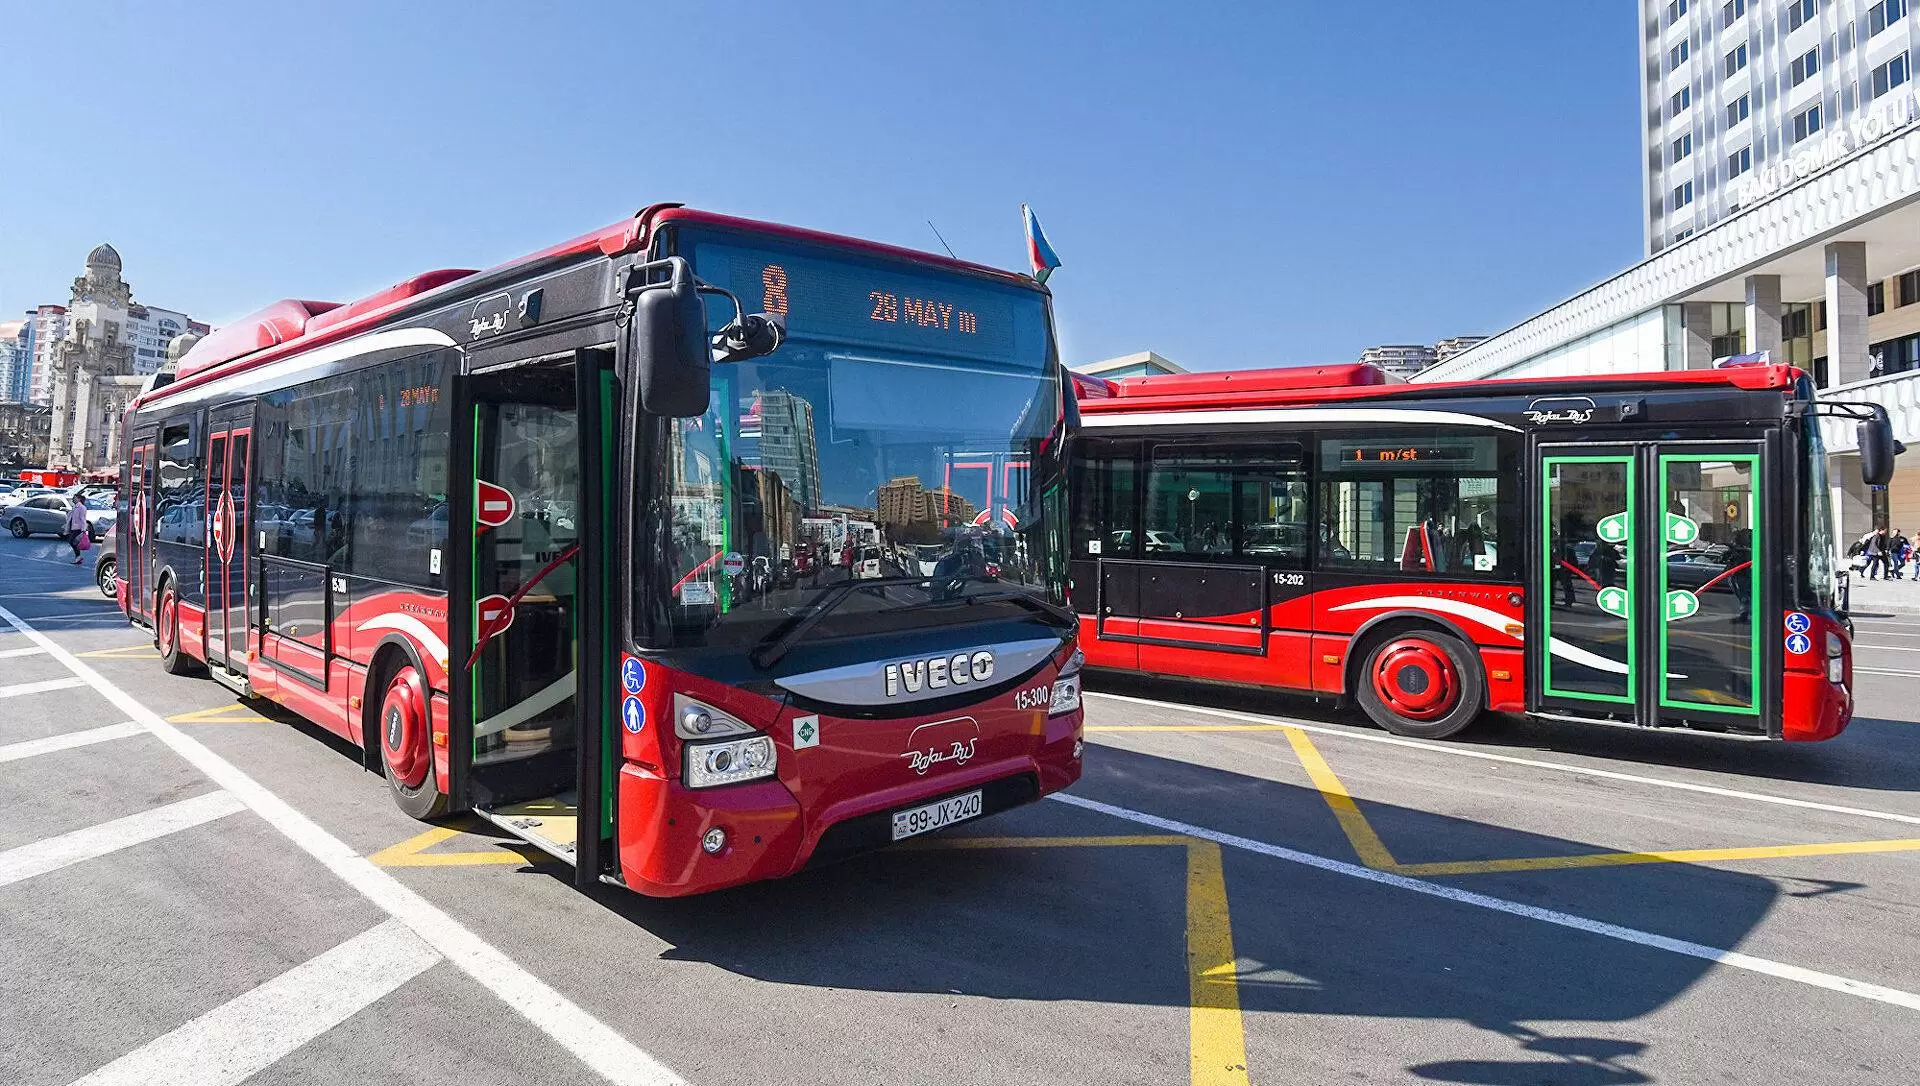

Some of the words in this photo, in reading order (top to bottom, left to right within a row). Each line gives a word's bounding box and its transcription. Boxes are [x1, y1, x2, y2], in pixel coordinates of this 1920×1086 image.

[763, 264, 788, 316] 8
[869, 291, 898, 322] 28
[904, 297, 952, 330] MAY
[958, 311, 976, 334] m
[1355, 449, 1362, 461] 1
[1380, 448, 1417, 461] m/st
[1273, 573, 1304, 586] 15-202
[885, 651, 994, 698] IVECO
[1014, 685, 1049, 710] 15-300
[800, 727, 813, 737] CNG
[900, 748, 946, 775] Baku
[951, 738, 978, 766] Bus
[909, 794, 979, 833] 99-JX-240
